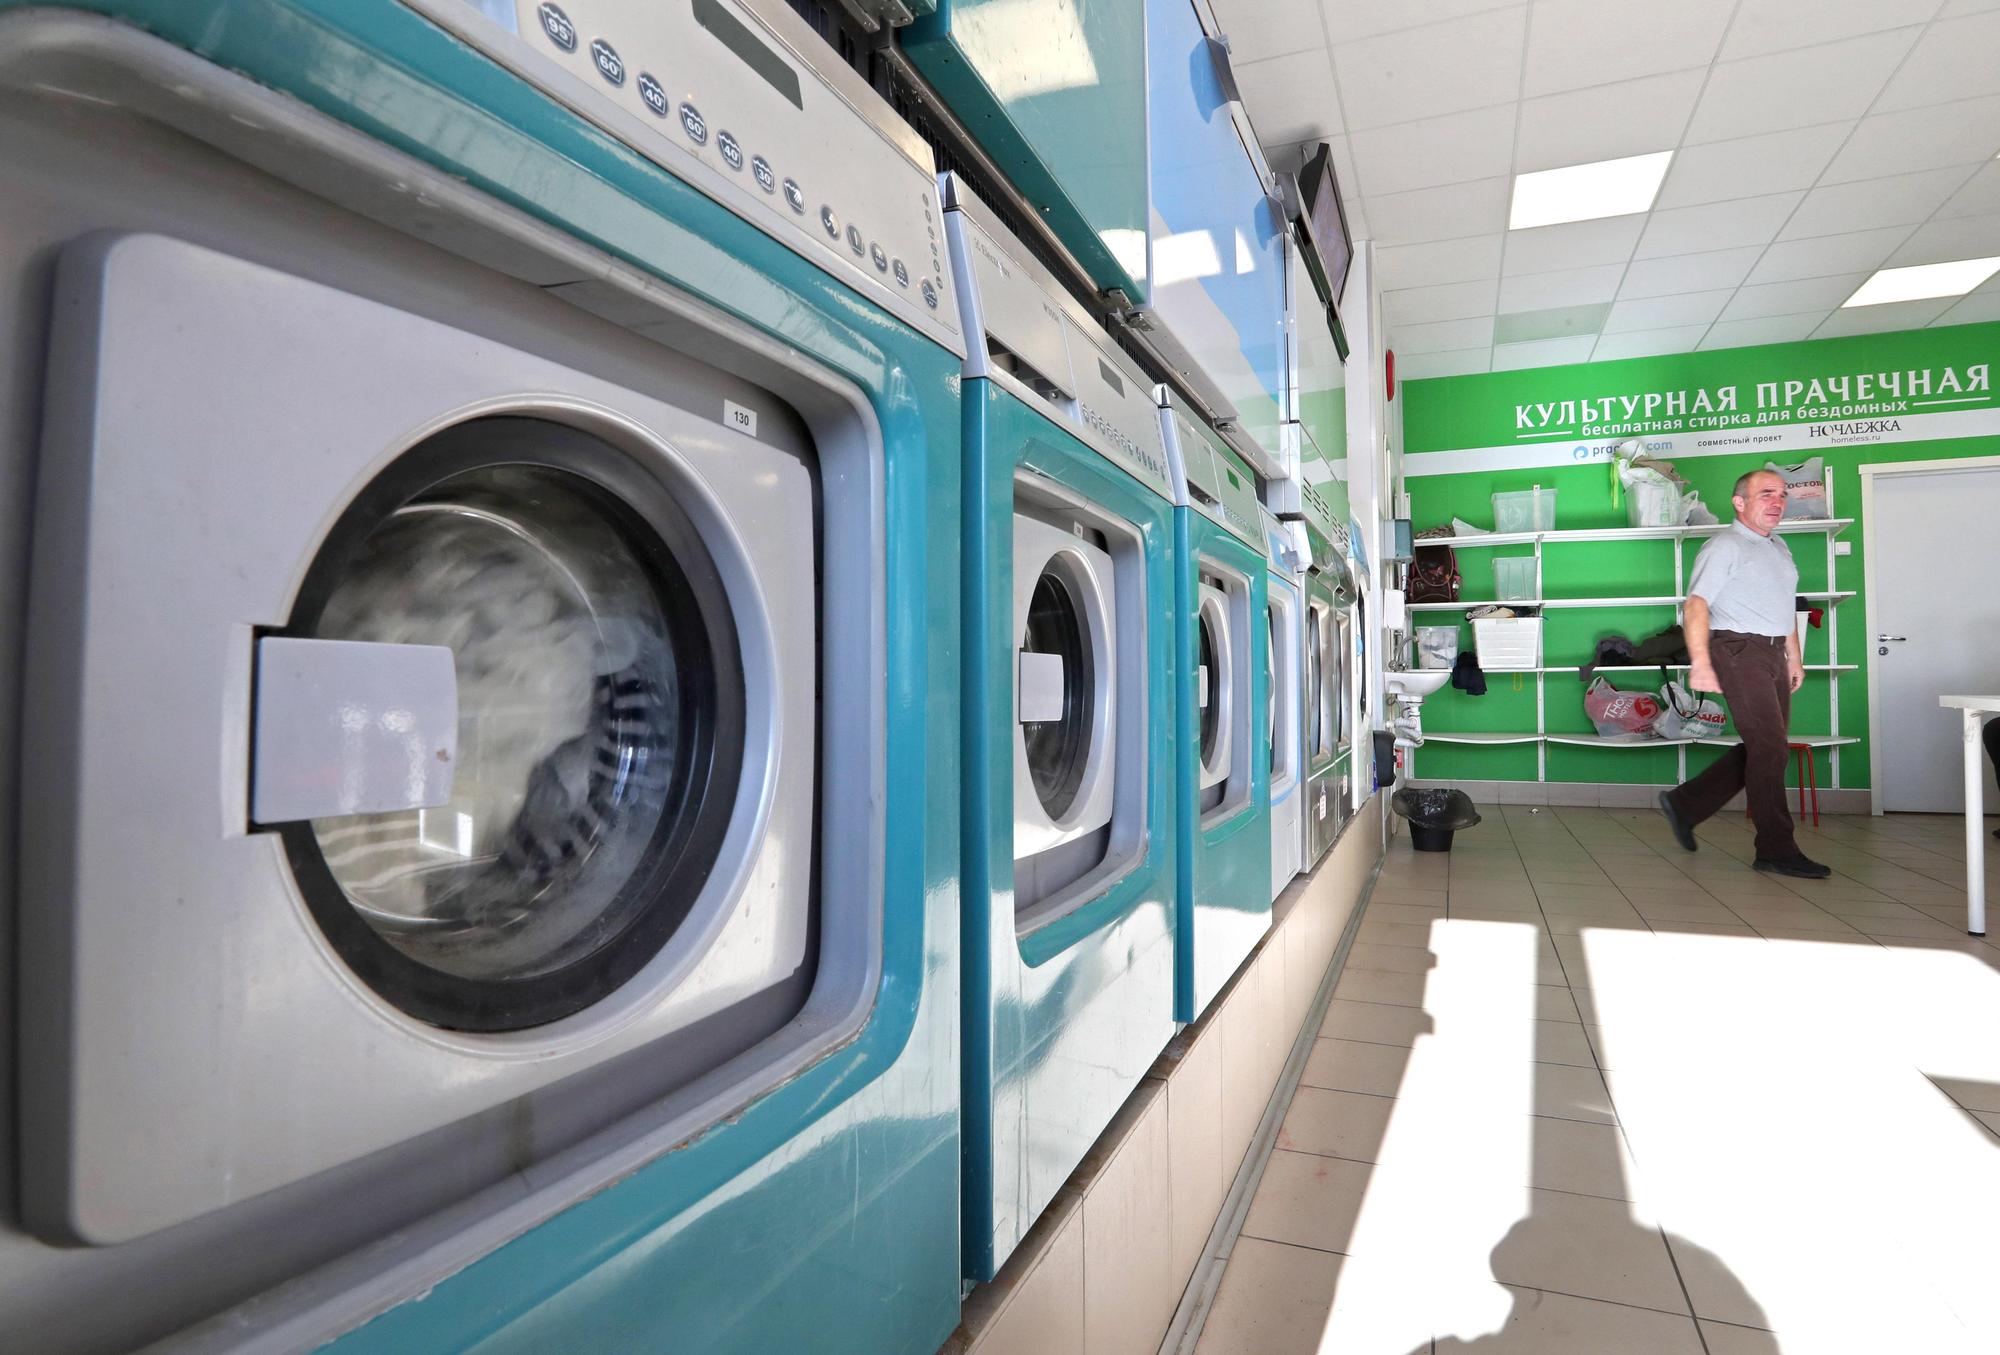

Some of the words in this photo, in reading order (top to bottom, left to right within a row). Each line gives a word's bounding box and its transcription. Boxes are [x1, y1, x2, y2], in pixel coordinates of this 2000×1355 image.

[1515, 386, 1737, 428] КУЛЬТУРНАЯ
[1756, 364, 1990, 408] ПРАЧЕЧНАЯ
[734, 410, 750, 426] 130
[1582, 417, 1682, 436] бесплатная
[1689, 413, 1751, 429] стирка
[1756, 410, 1790, 425] для
[1797, 401, 1908, 419] бездомных
[1809, 420, 1902, 437] НОЧЛЕЖКА
[1697, 435, 1750, 447] совместный
[1753, 434, 1782, 444] проект
[1831, 434, 1881, 444] homeless.ru
